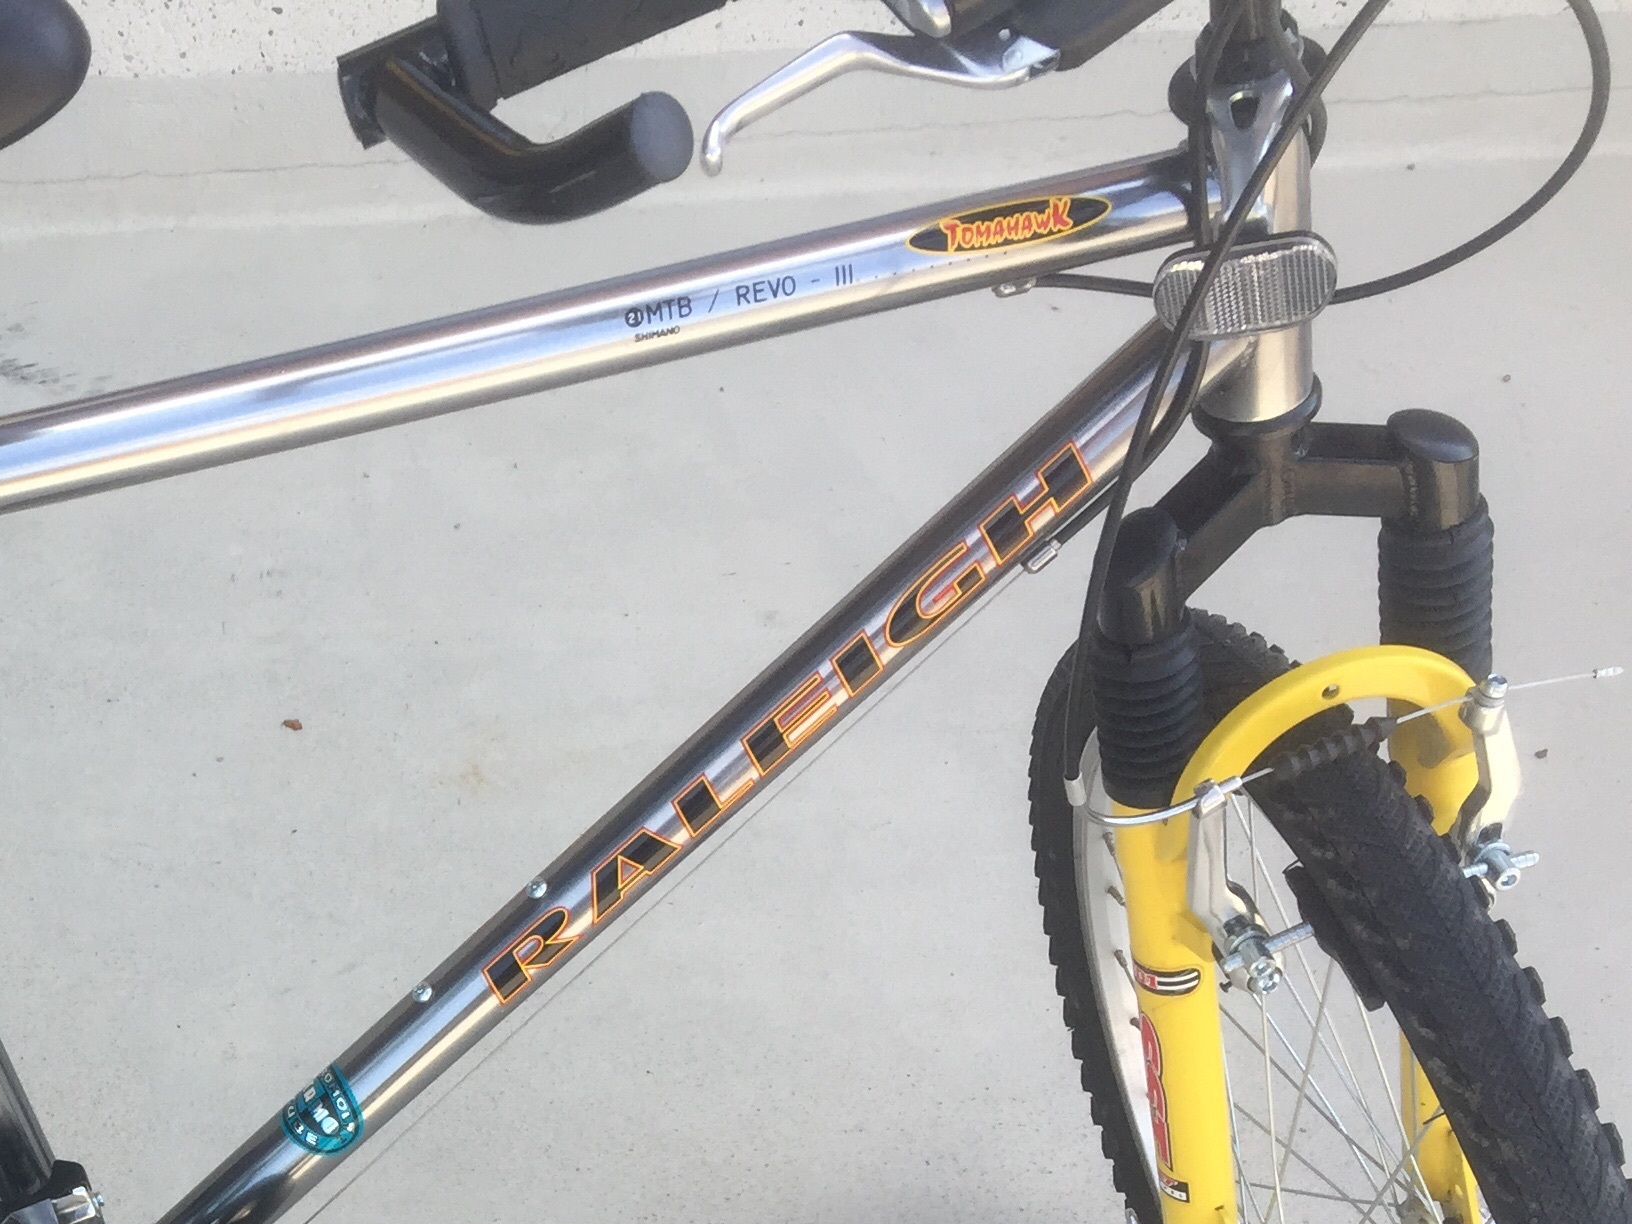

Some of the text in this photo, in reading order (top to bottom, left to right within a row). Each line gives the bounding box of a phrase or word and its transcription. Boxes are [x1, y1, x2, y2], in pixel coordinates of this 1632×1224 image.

[940, 196, 1074, 253] TOMAHAWK
[734, 274, 797, 307] REVO
[834, 263, 854, 287] III
[633, 324, 681, 343] SHIMANO
[481, 440, 1094, 1005] RALEIGH
